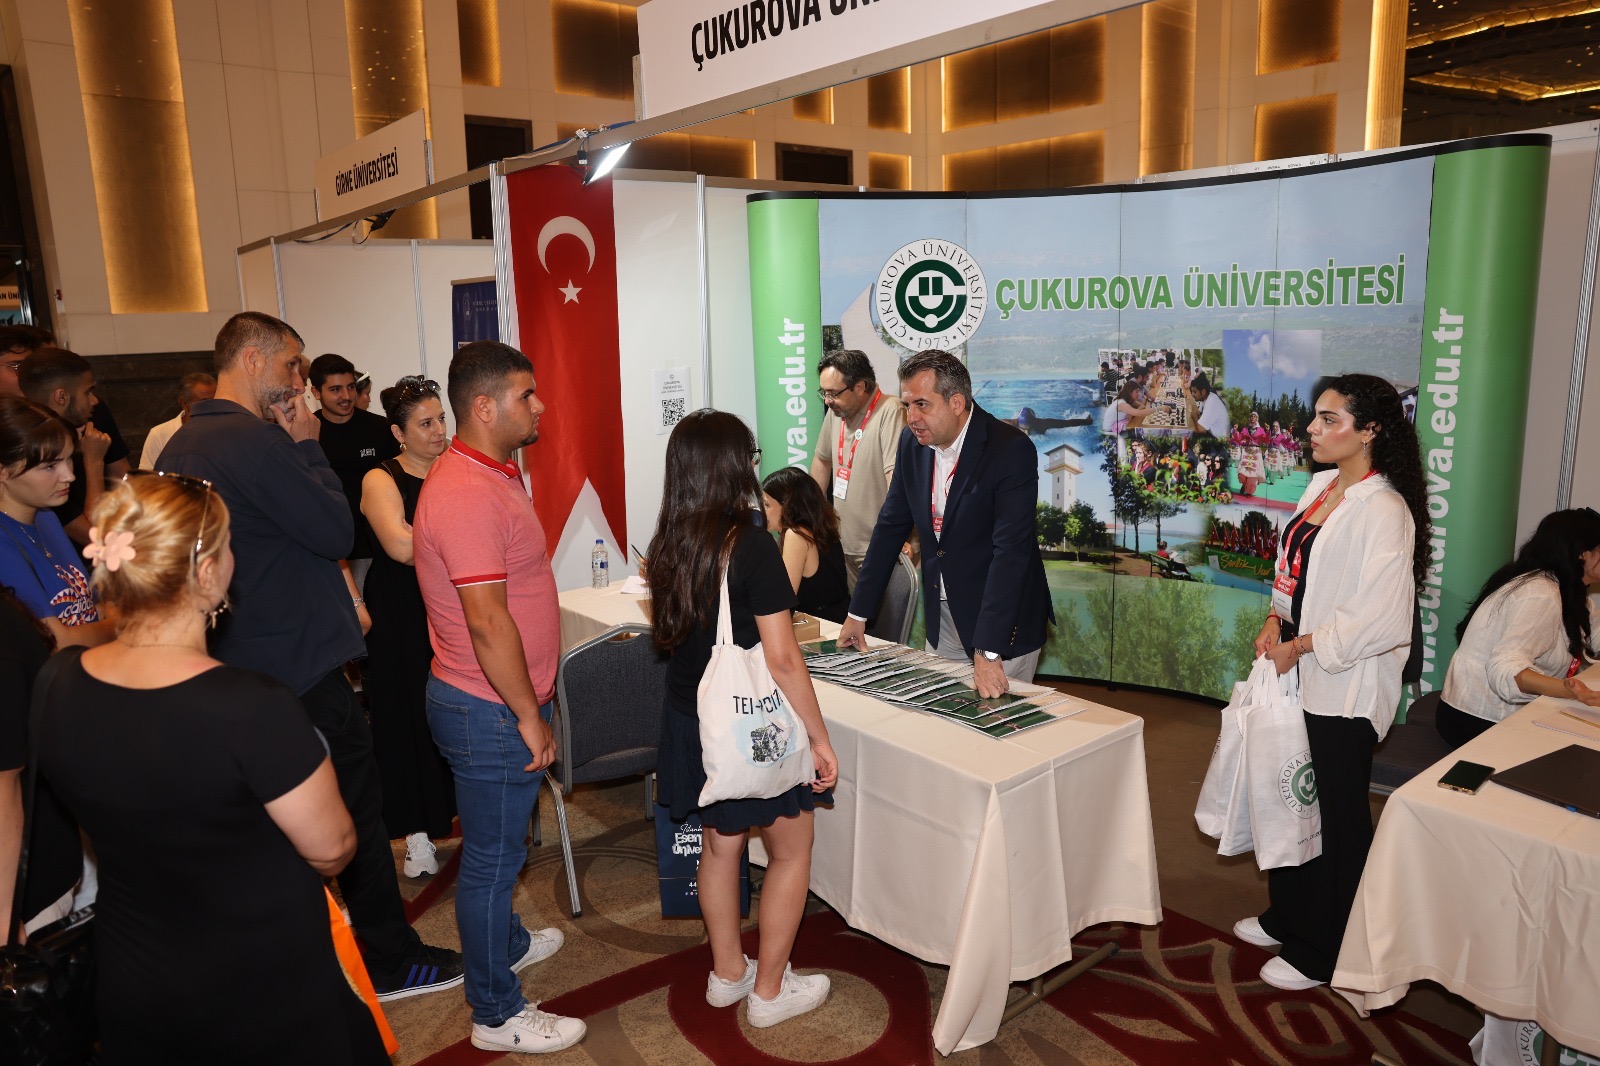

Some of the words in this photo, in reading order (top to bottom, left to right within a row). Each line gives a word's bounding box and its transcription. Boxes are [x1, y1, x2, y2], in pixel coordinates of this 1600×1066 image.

[691, 0, 822, 71] ÇUKUROVA
[335, 170, 353, 196] GİRNE
[353, 146, 399, 190] ÜNİVERSİTESİ
[880, 249, 918, 338] ÇUKUROVA
[923, 242, 986, 338] ÜNİVERSİTESİ
[995, 272, 1174, 320] ÇUKUROVA
[1183, 253, 1406, 309] ÜNİVERSİTESİ
[917, 335, 950, 349] 1973
[778, 318, 808, 475] va.edu.tr
[1520, 1021, 1539, 1066] UKURO
